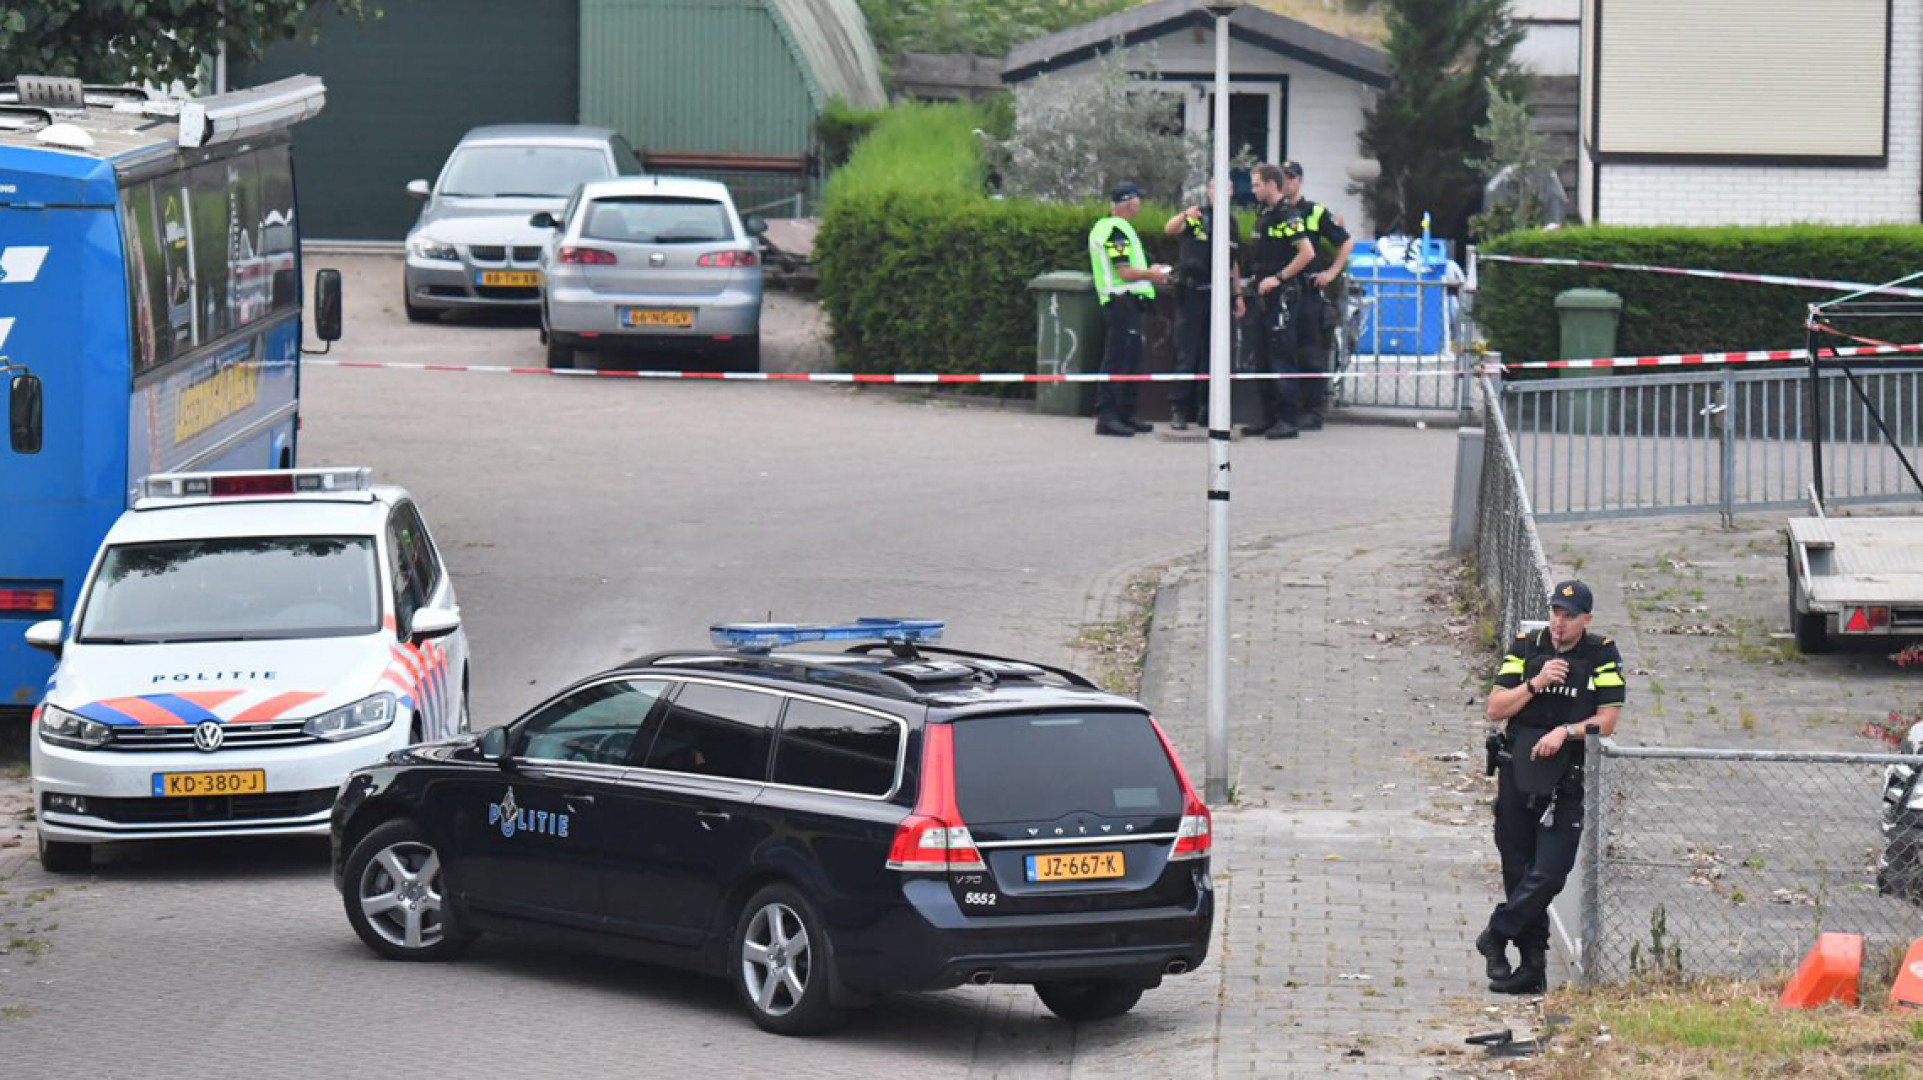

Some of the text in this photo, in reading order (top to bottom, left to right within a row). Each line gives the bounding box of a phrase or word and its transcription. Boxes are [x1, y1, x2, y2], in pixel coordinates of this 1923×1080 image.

[152, 671, 277, 683] POLITIE
[170, 774, 257, 794] KD-380-J
[1027, 824, 1135, 836] VOLVO
[1043, 855, 1117, 877] JZ-667-K
[965, 891, 996, 905] 5552
